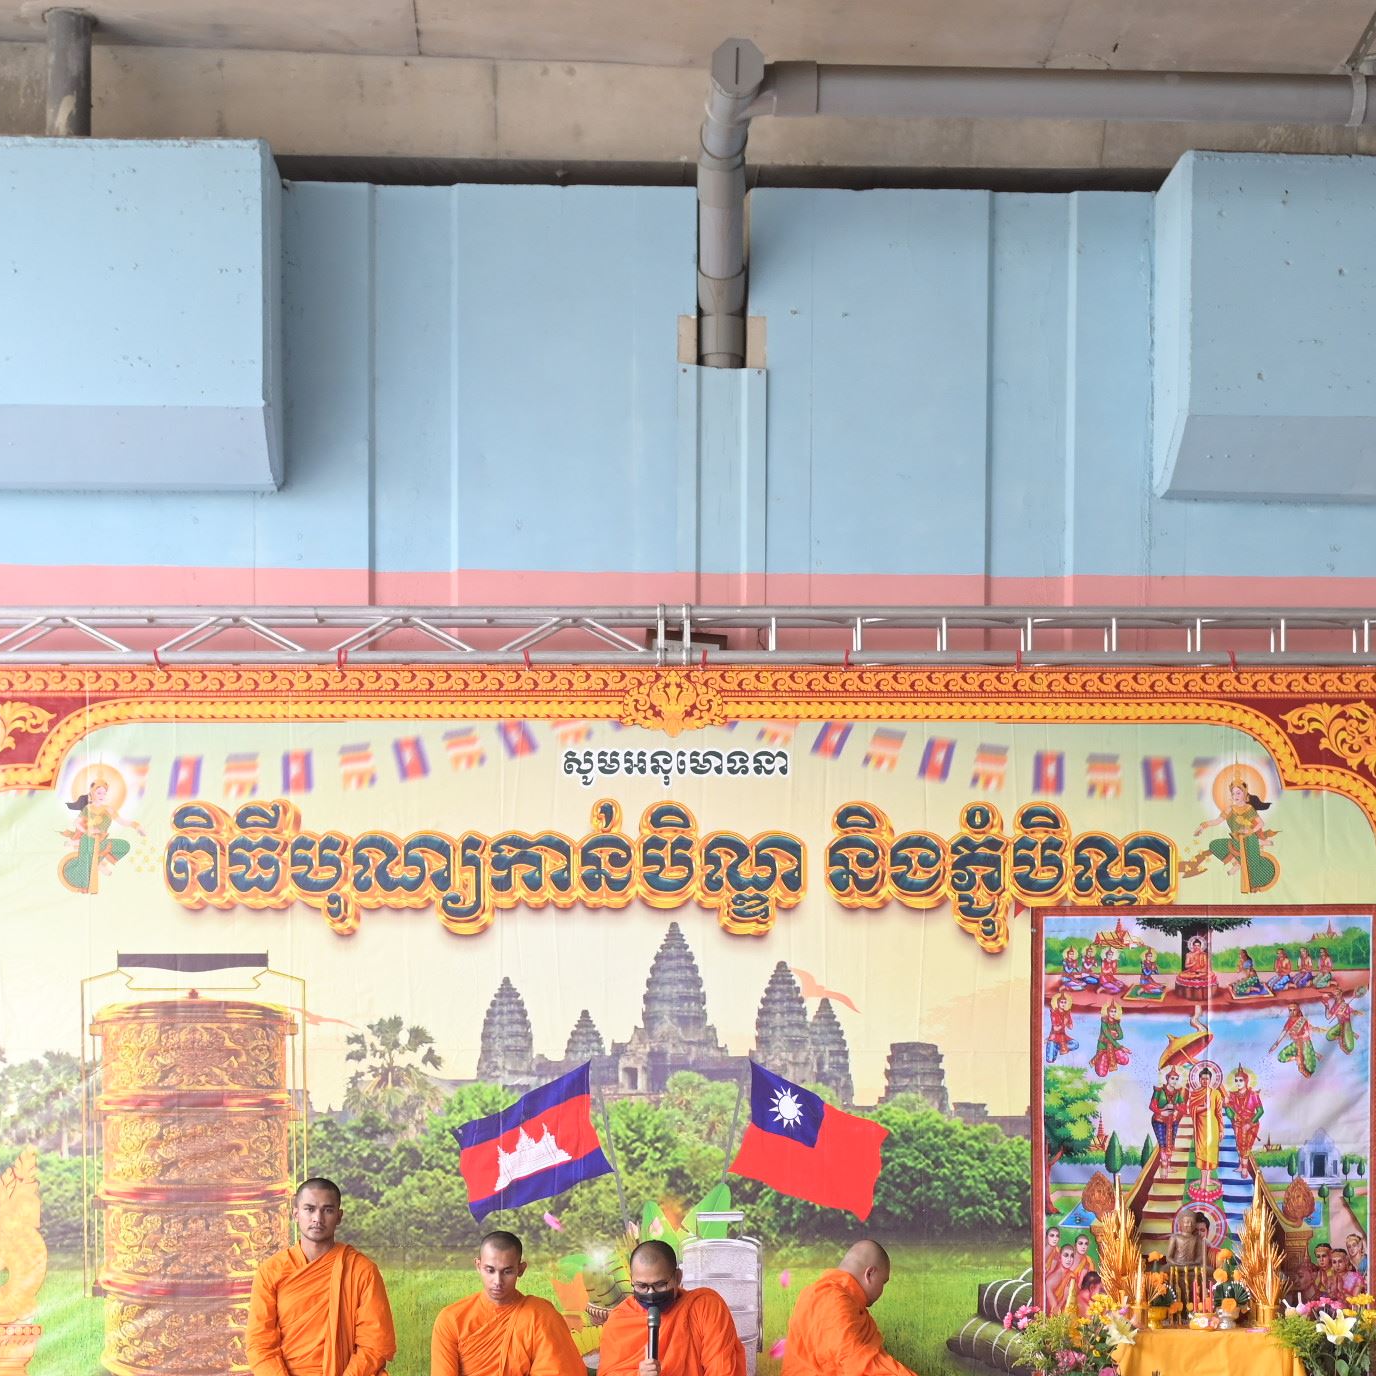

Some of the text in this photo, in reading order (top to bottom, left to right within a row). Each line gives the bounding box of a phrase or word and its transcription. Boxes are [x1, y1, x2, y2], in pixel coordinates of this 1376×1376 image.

[563, 750, 789, 786] សូមអនុមោទនា
[162, 799, 807, 928] ពិធីបុណ្យកាន់បិណ្ឌ
